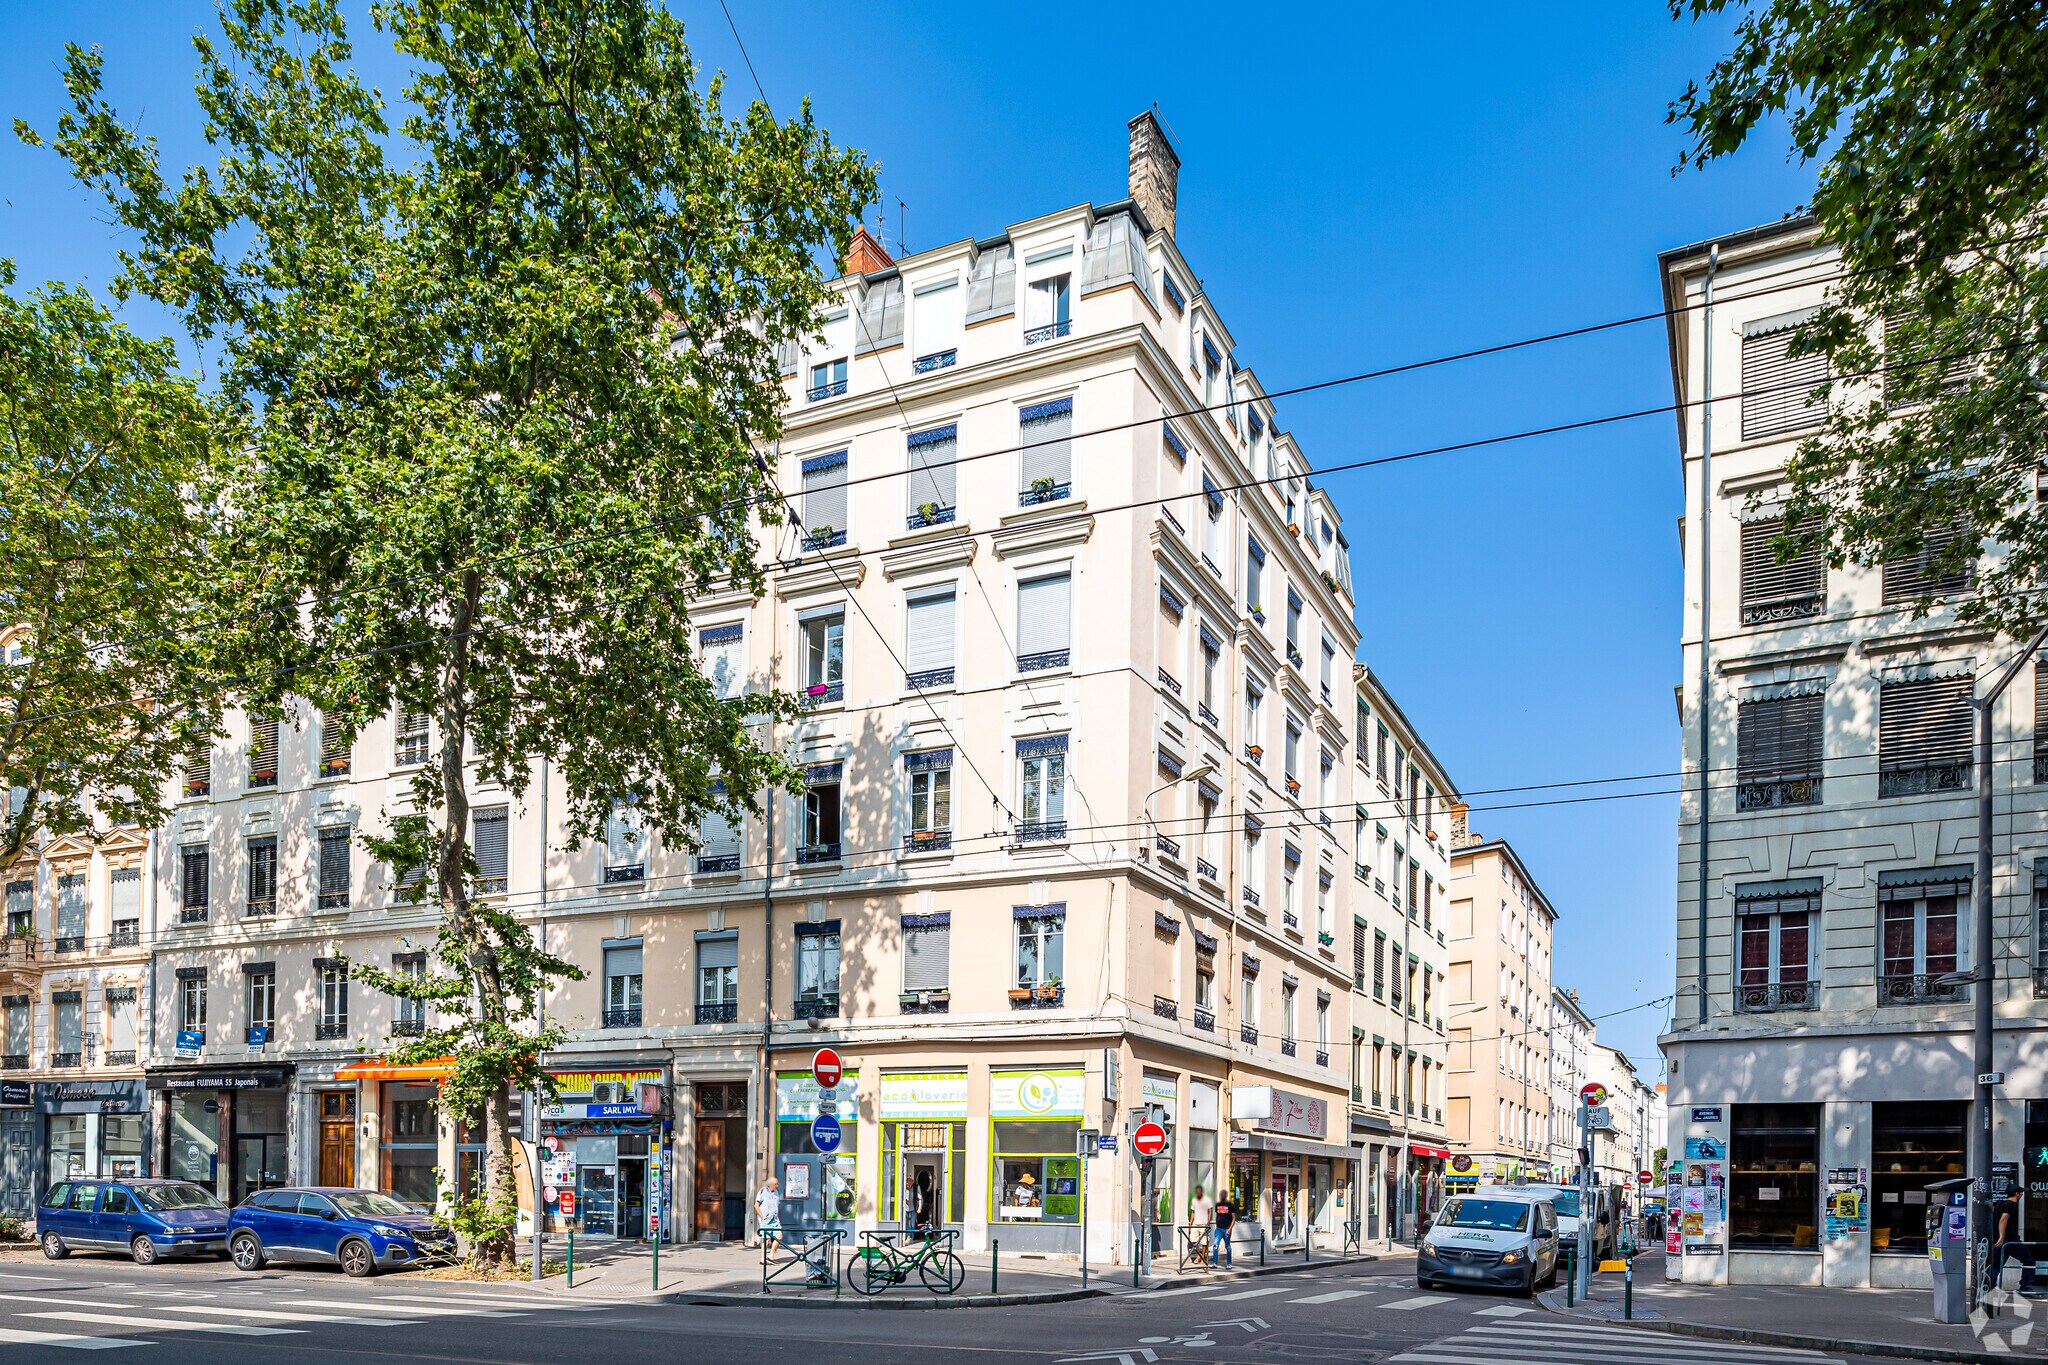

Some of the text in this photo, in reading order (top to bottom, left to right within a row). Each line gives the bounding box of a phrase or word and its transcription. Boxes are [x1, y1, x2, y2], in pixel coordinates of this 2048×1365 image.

[234, 1078, 259, 1086] Japonais
[603, 1106, 621, 1114] SARL
[1954, 1192, 1965, 1205] P
